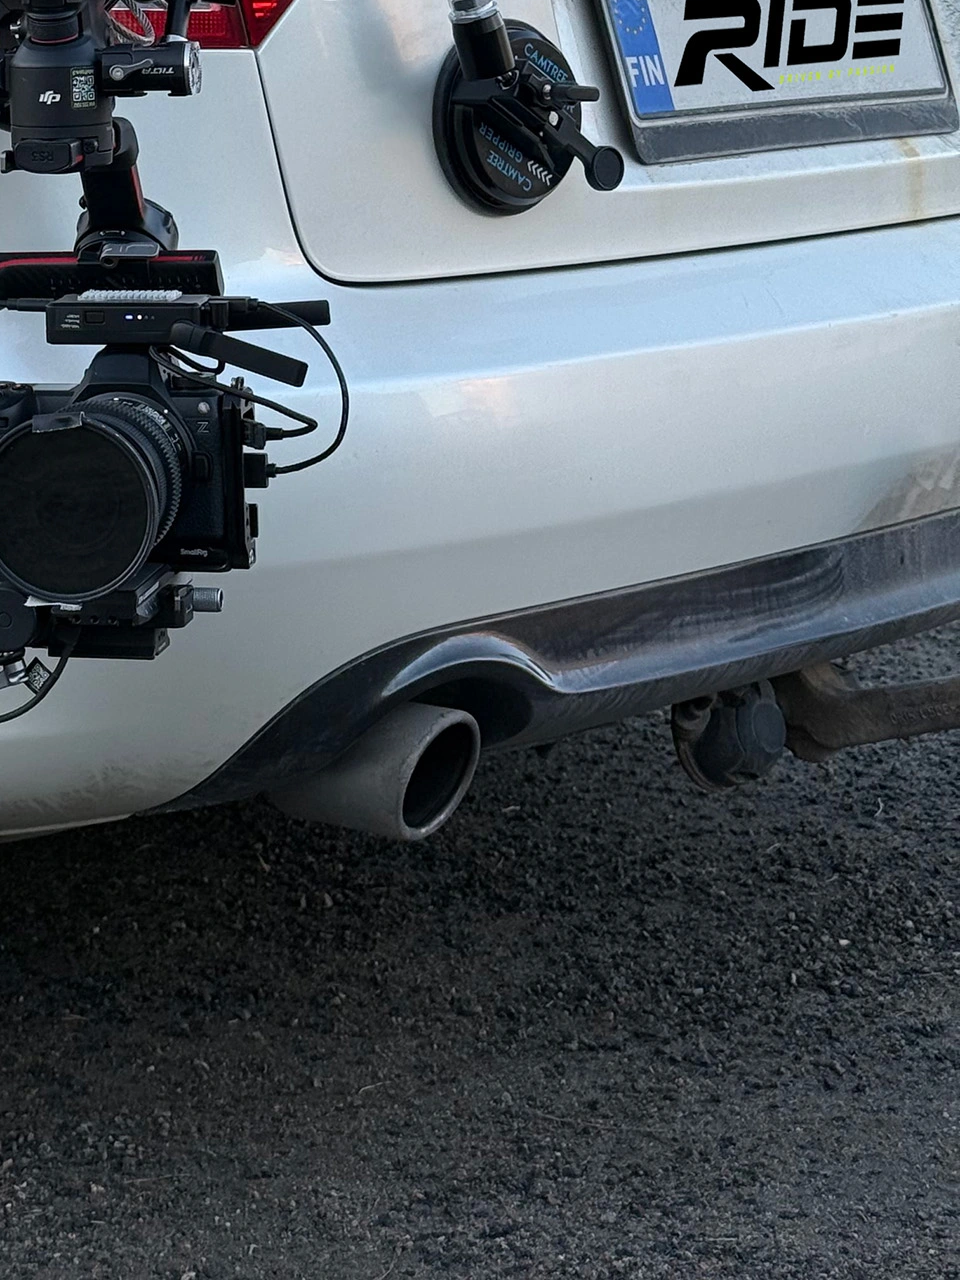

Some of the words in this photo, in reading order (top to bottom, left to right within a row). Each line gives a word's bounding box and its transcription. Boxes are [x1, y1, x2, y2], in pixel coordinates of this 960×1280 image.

[141, 66, 175, 75] TILTA
[524, 42, 568, 81] CAMTREE
[627, 54, 665, 88] FIN
[478, 121, 524, 164] GRIPPER
[487, 149, 533, 192] CAMTREE
[197, 421, 209, 433] Z
